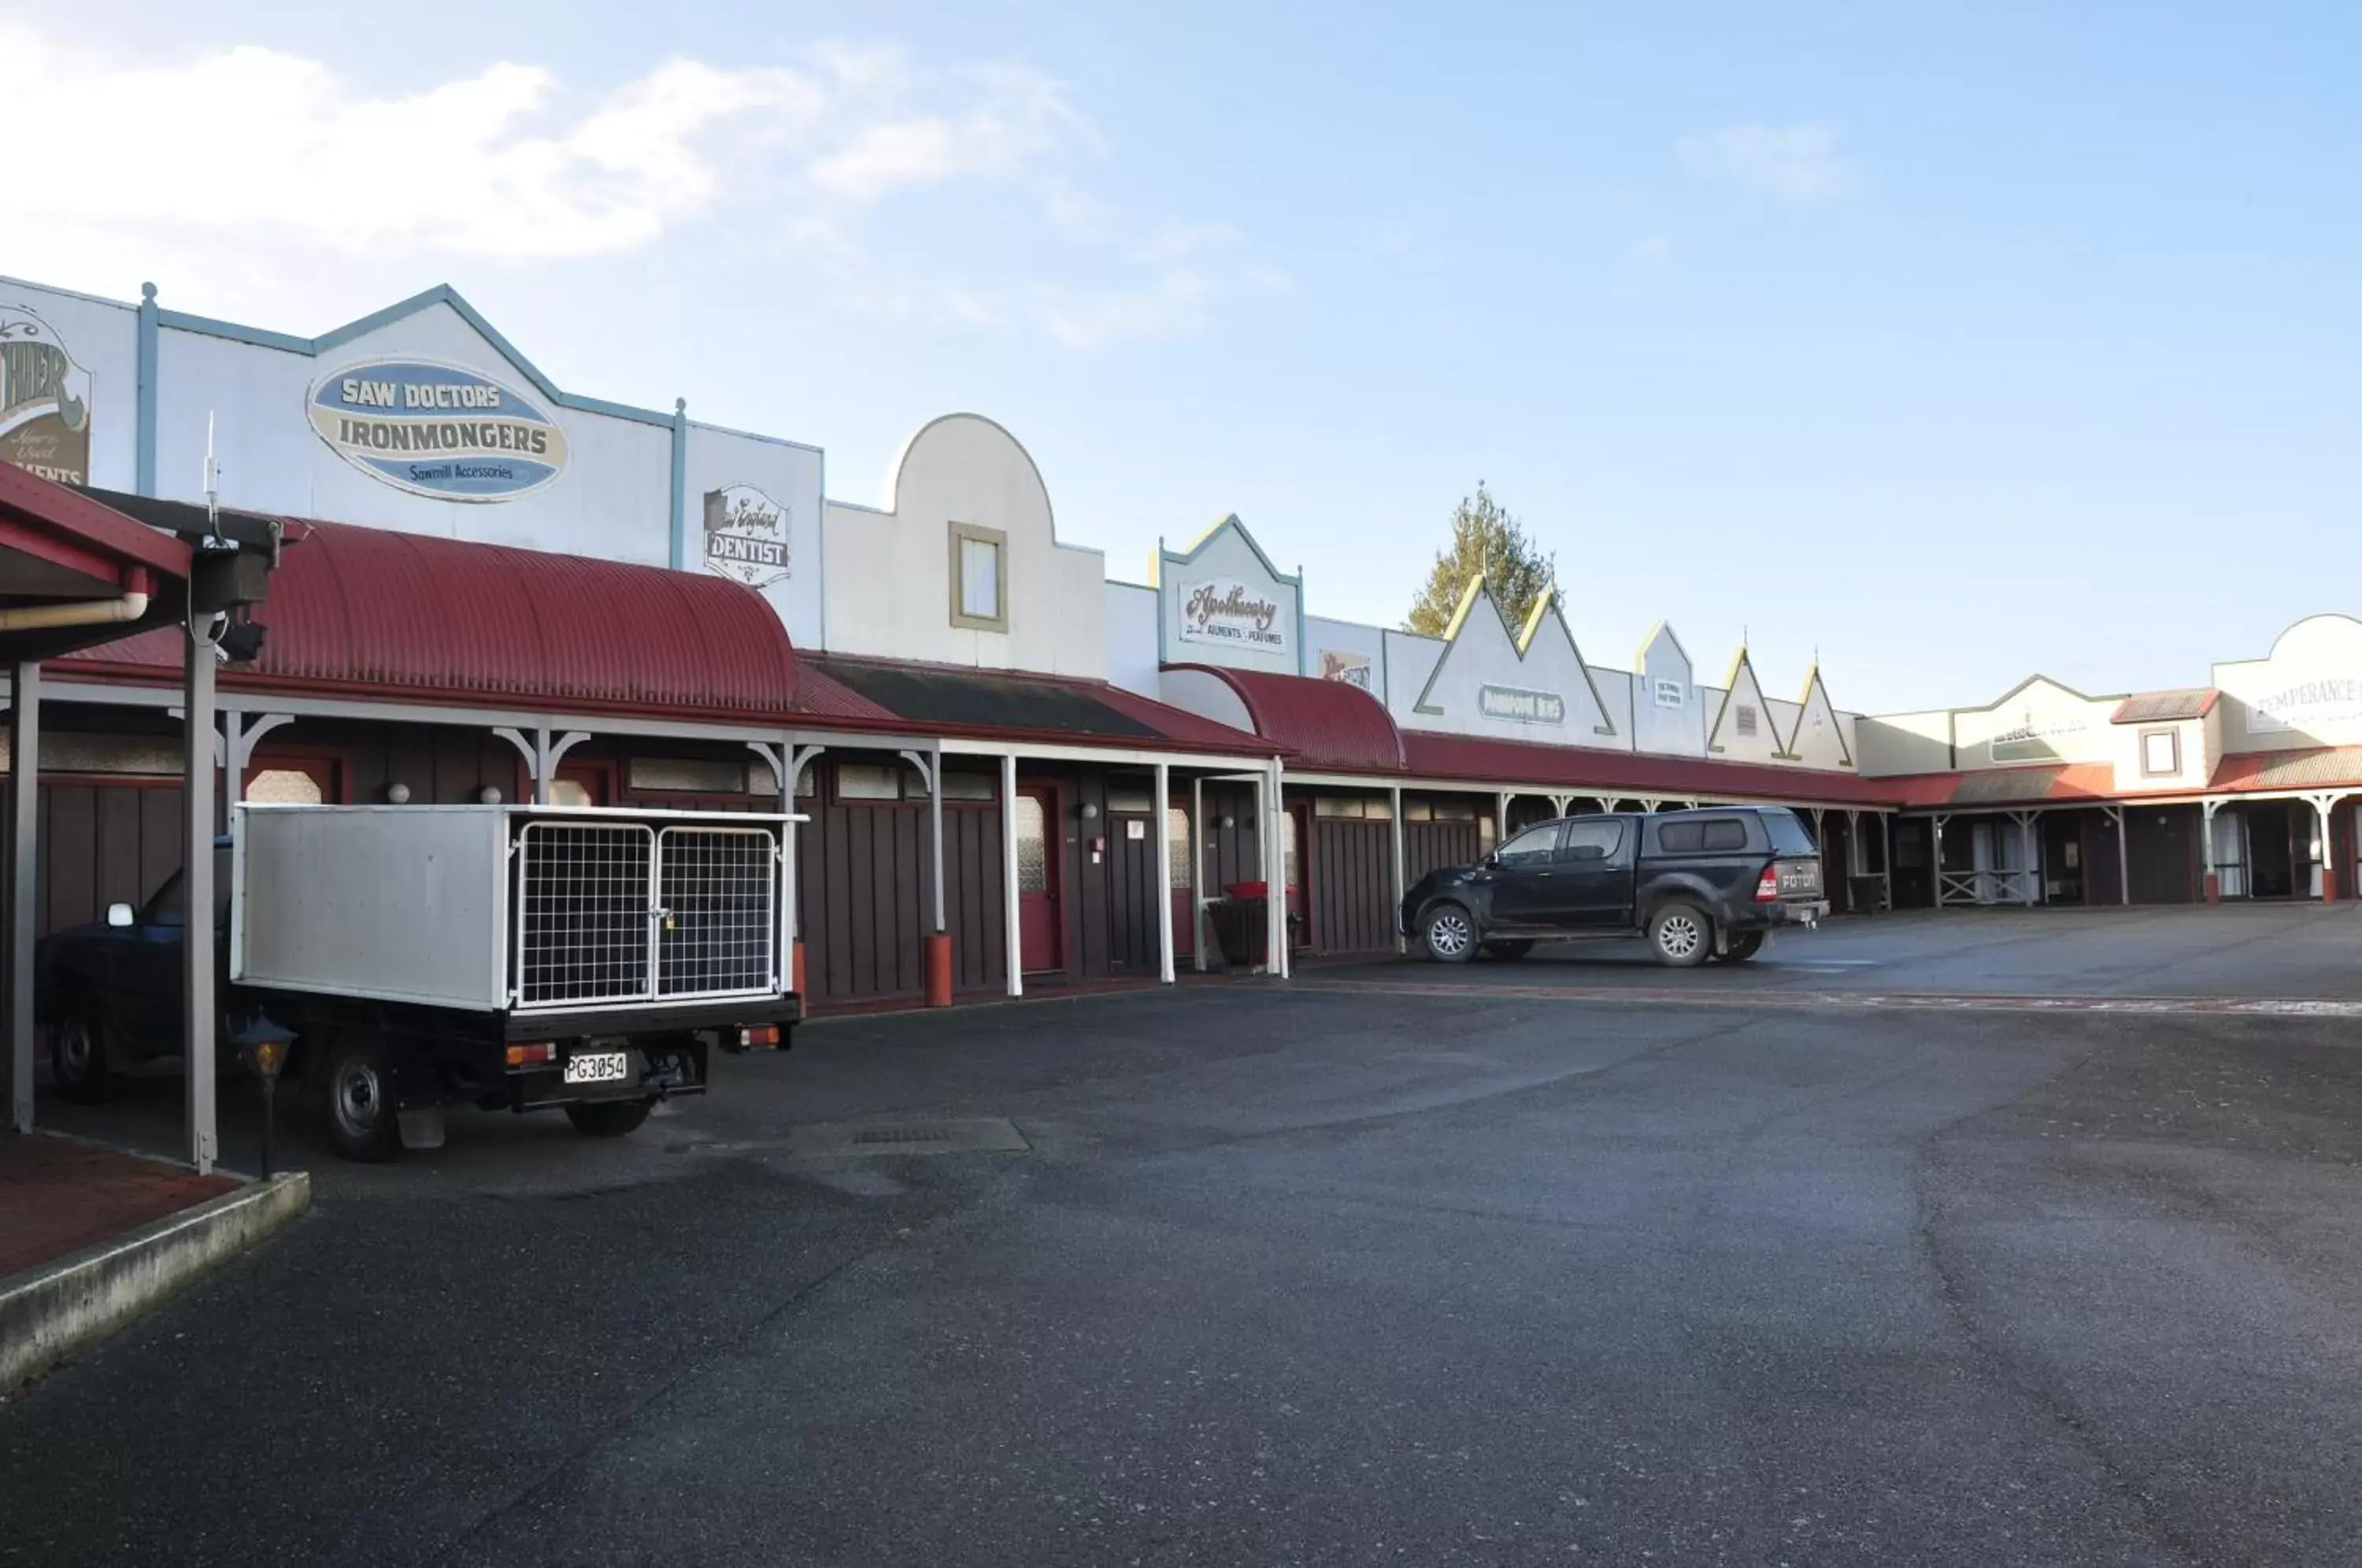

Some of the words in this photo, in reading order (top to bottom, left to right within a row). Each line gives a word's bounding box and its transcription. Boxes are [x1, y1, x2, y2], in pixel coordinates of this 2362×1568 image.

[341, 379, 397, 407] SAW
[405, 383, 500, 408] DOCTORS
[339, 418, 547, 455] IRONMONGERS
[409, 464, 453, 481] Sawmill
[455, 463, 513, 479] Accessories
[711, 534, 784, 564] DENTIST
[1187, 584, 1277, 631] Apothecary
[566, 1057, 624, 1080] PG3054
